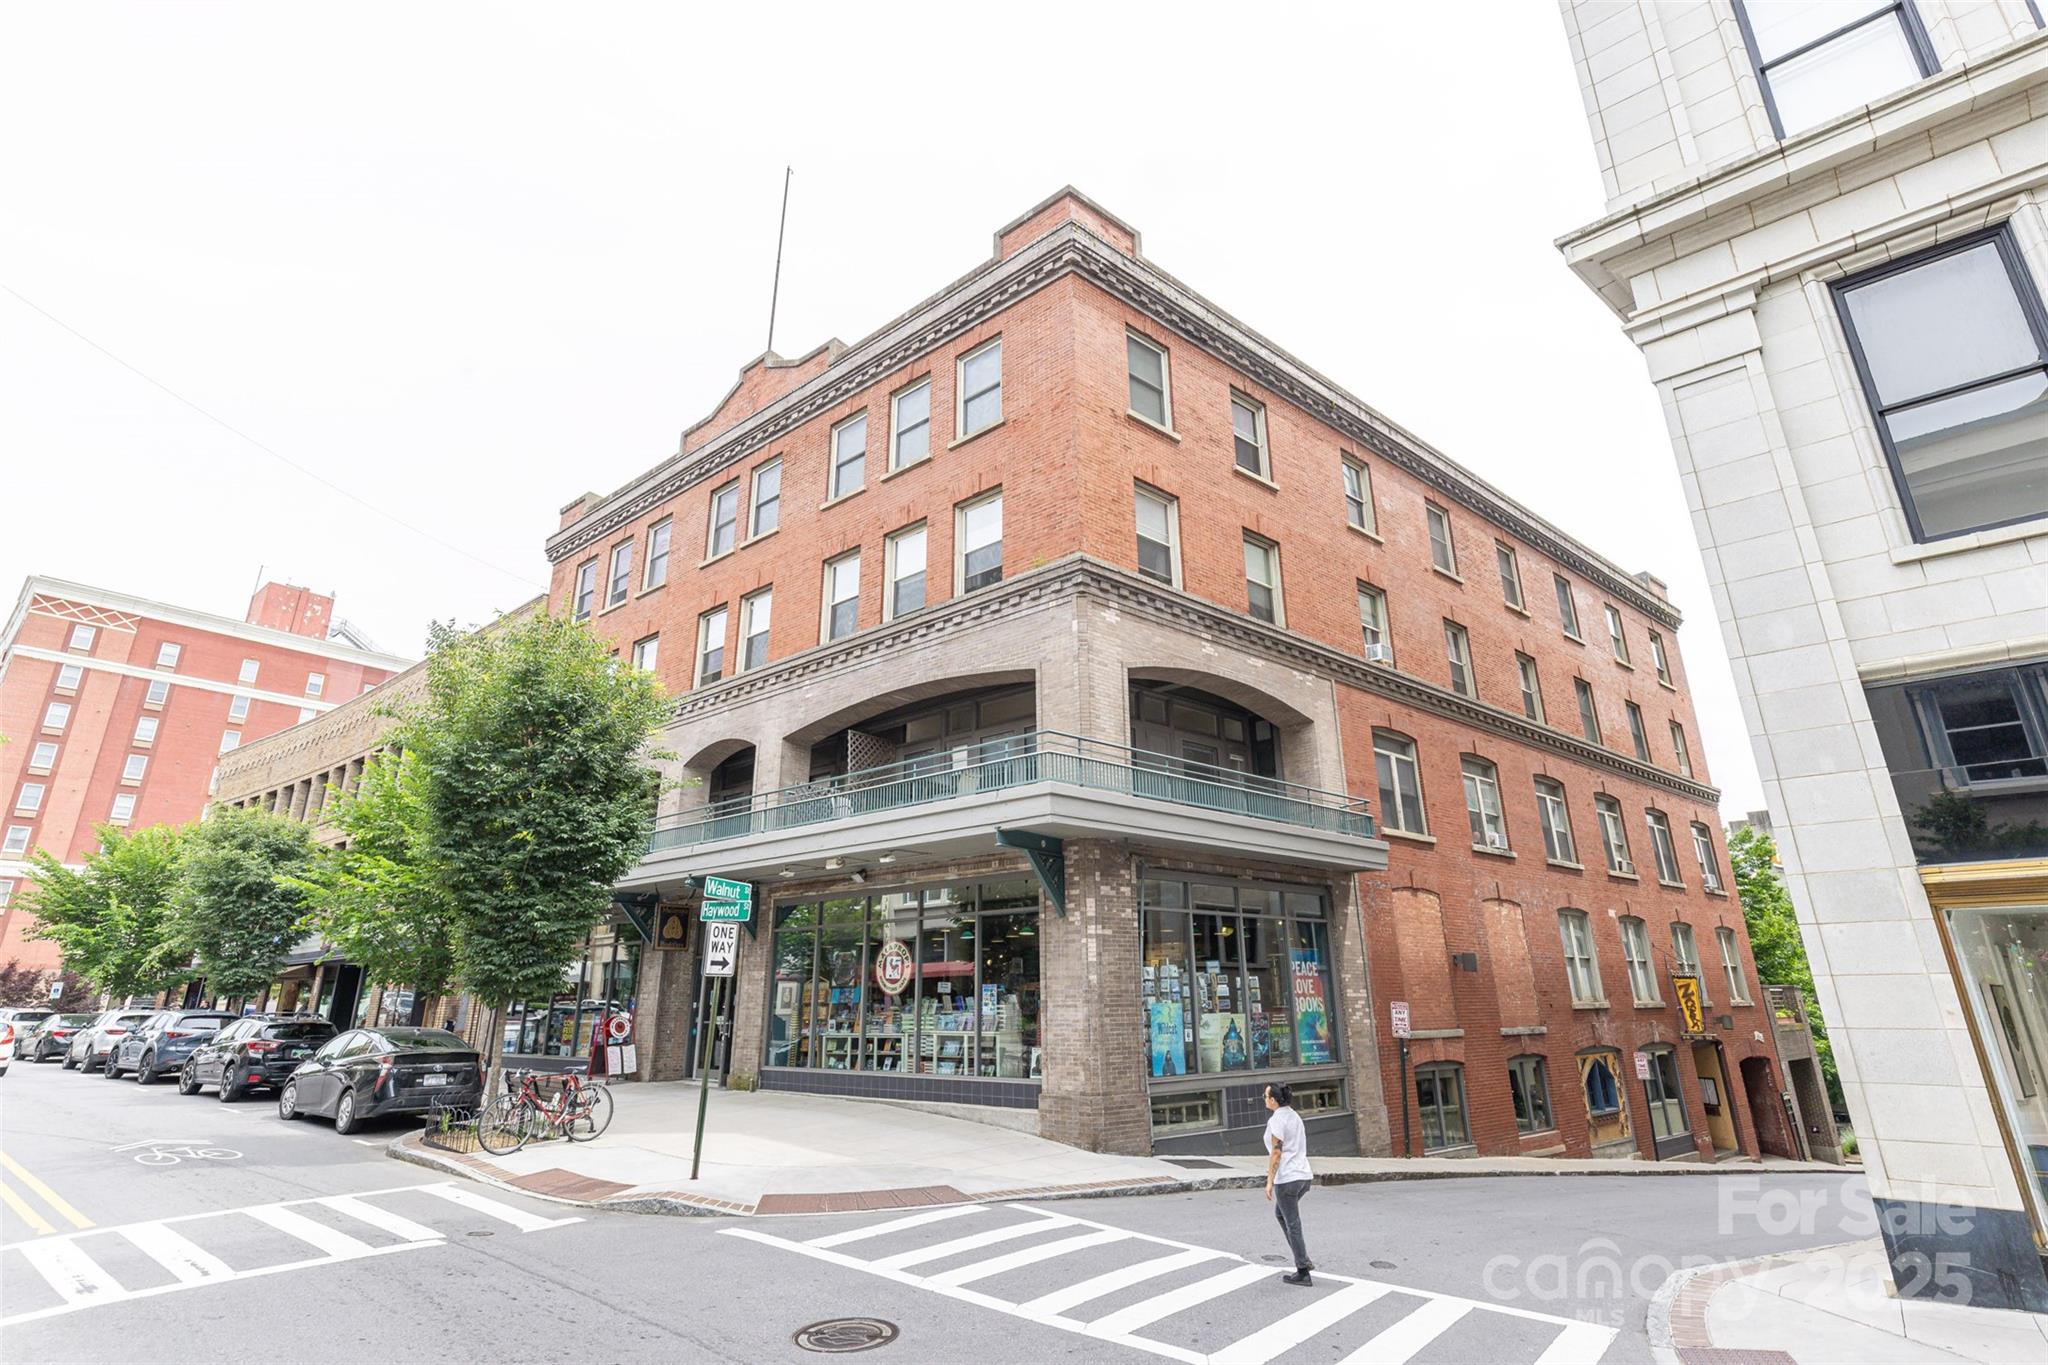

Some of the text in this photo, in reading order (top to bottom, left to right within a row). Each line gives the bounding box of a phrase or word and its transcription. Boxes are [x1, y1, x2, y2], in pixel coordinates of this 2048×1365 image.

[707, 879, 741, 899] Walnut
[703, 904, 740, 919] Haywood
[713, 926, 735, 939] ONE
[711, 941, 734, 953] WAY
[1294, 979, 1315, 994] OVE
